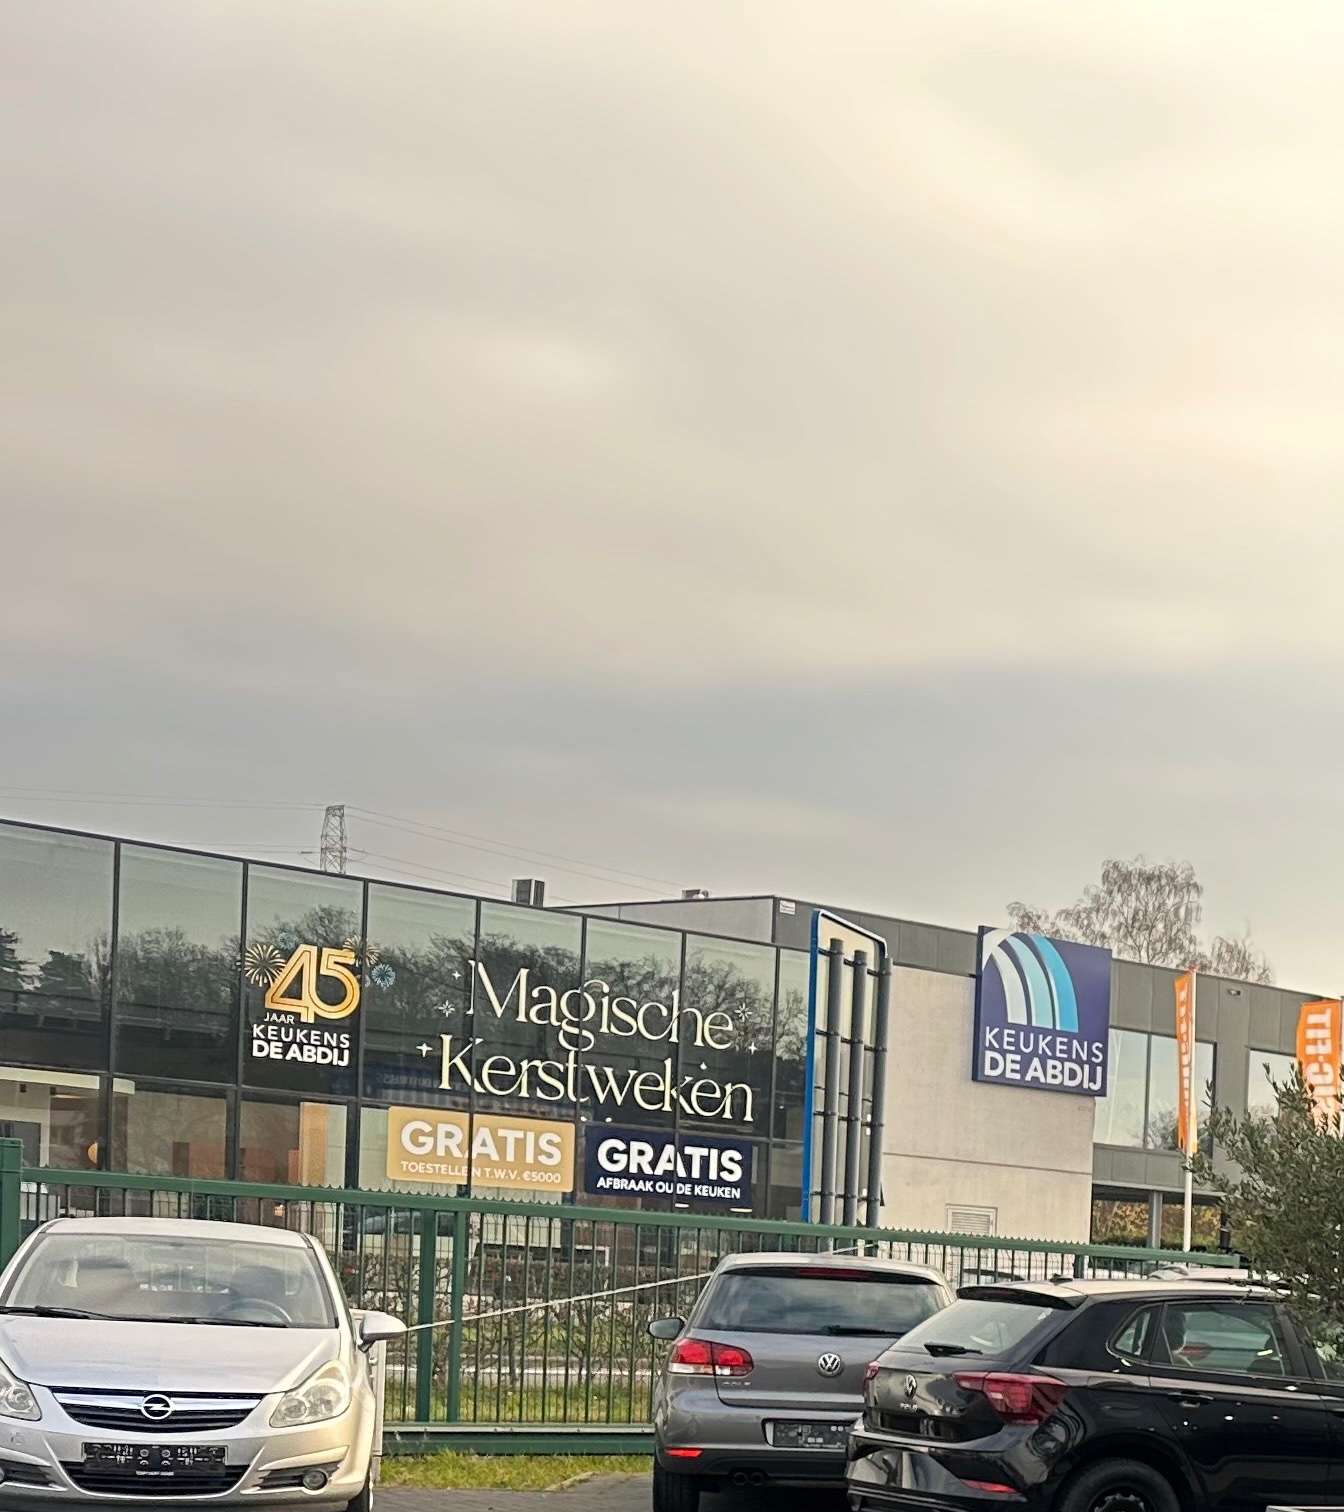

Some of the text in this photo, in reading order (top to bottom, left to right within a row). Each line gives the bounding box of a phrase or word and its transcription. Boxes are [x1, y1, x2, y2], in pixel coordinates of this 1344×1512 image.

[264, 943, 360, 1024] 45
[264, 1011, 295, 1024] JAAR
[466, 959, 734, 1052] Magische
[252, 1023, 351, 1049] KEUKENS
[252, 1039, 350, 1067] DE ABDIJ
[985, 1025, 1104, 1063] KEUKENS
[439, 1033, 755, 1122] Kerstweken
[984, 1050, 1103, 1091] DE ABDIJ
[399, 1119, 562, 1165] GRATIS
[597, 1138, 743, 1182] GRATIS
[400, 1160, 562, 1184] TOESTELLEN T.W.V. €5000
[596, 1176, 654, 1193] AFBRAAK
[694, 1184, 741, 1199] KEUKEN
